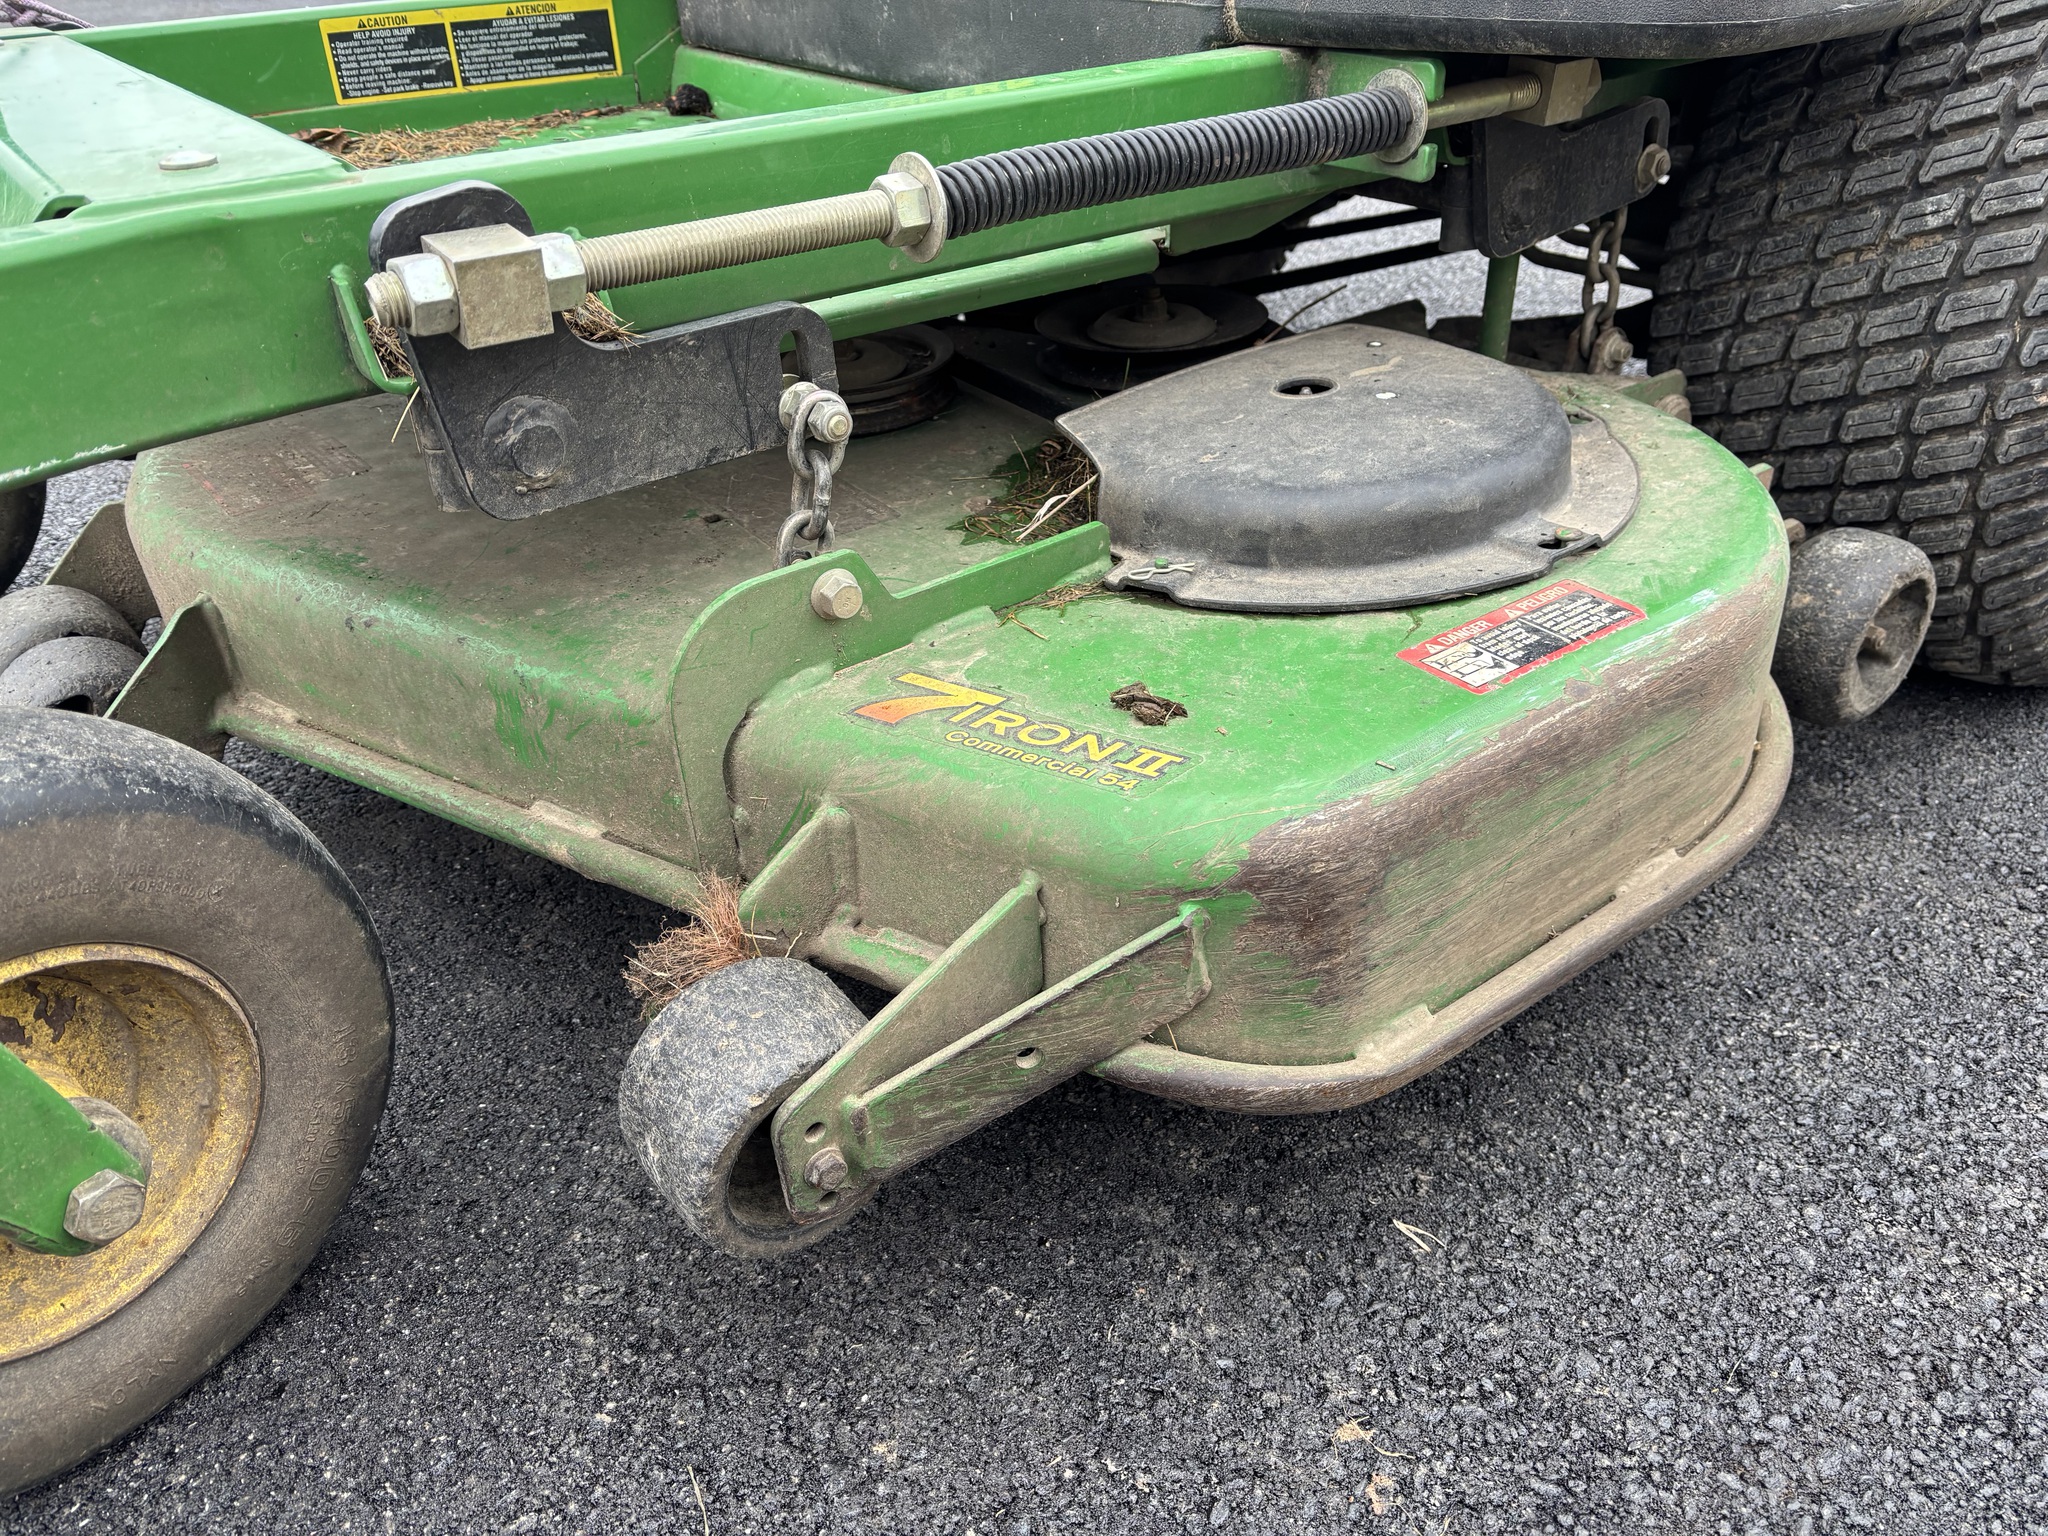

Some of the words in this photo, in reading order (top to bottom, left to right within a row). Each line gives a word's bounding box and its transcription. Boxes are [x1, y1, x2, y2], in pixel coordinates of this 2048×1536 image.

[515, 4, 556, 15] ATENCION
[367, 15, 408, 28] CAUTION
[492, 18, 517, 26] AYUDAR
[546, 13, 574, 21] LESIONES
[371, 29, 391, 37] AVOID
[392, 27, 415, 35] INJURY
[335, 40, 360, 48] Operator
[386, 49, 408, 57] machine
[359, 74, 378, 82] people
[397, 70, 420, 78] distance
[1519, 586, 1569, 611] PELIGRO
[1437, 620, 1493, 645] DANGER
[944, 729, 1093, 781] Commercial
[1097, 770, 1141, 792] 54
